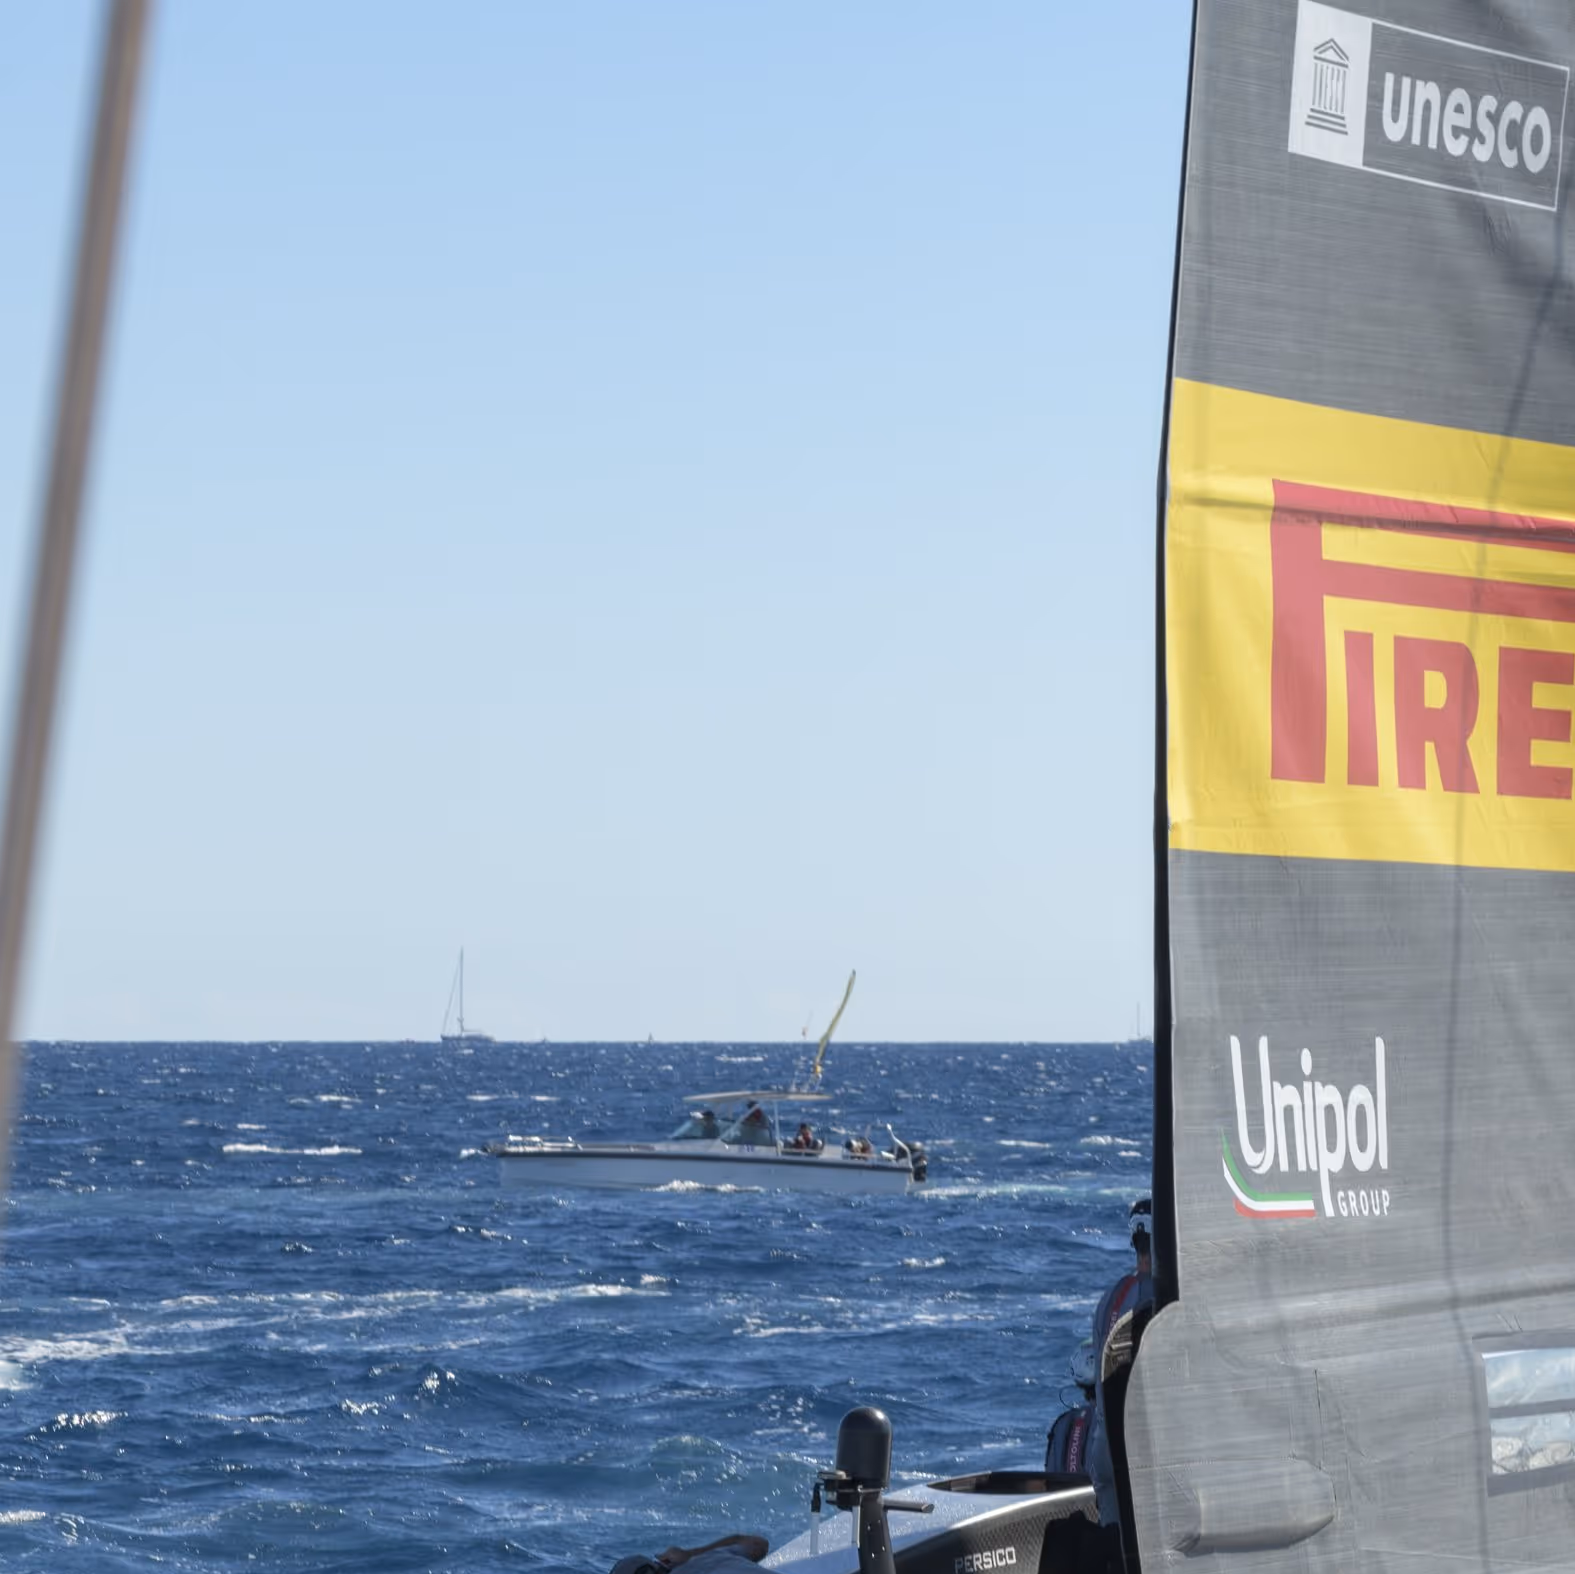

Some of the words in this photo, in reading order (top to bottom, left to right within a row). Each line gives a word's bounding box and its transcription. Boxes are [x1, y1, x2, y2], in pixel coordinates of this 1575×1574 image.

[1382, 72, 1552, 174] unesco
[1229, 1035, 1388, 1218] Unipol
[1336, 1190, 1391, 1217] GROUP
[1069, 1425, 1081, 1473] OLTOLINI
